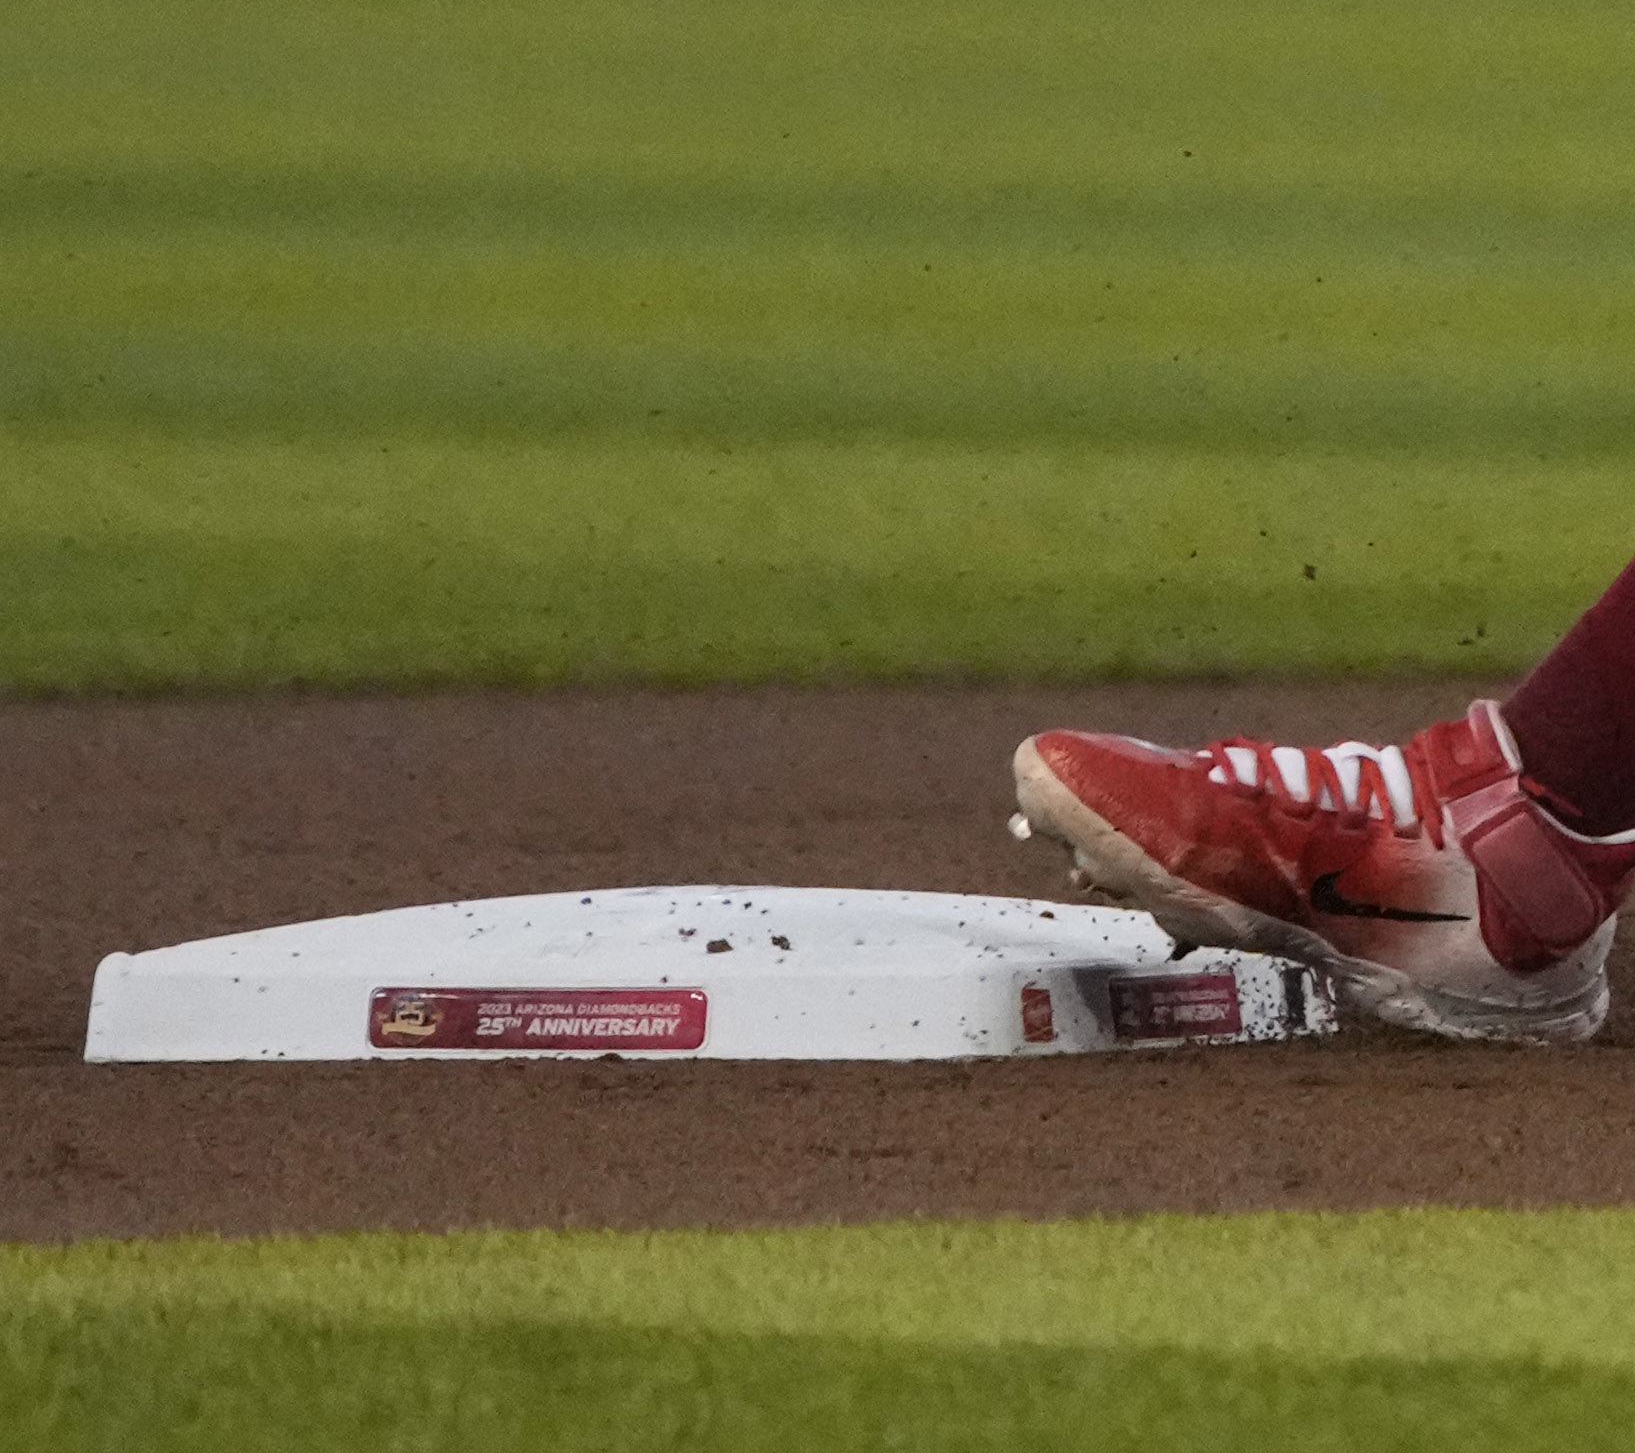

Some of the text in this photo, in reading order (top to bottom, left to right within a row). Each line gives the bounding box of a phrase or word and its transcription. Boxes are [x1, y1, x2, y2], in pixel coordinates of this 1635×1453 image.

[514, 1003, 574, 1015] ARIZONA
[576, 1003, 683, 1015] DIAMONDBACKS
[524, 1017, 682, 1036] ANNIVERSARY
